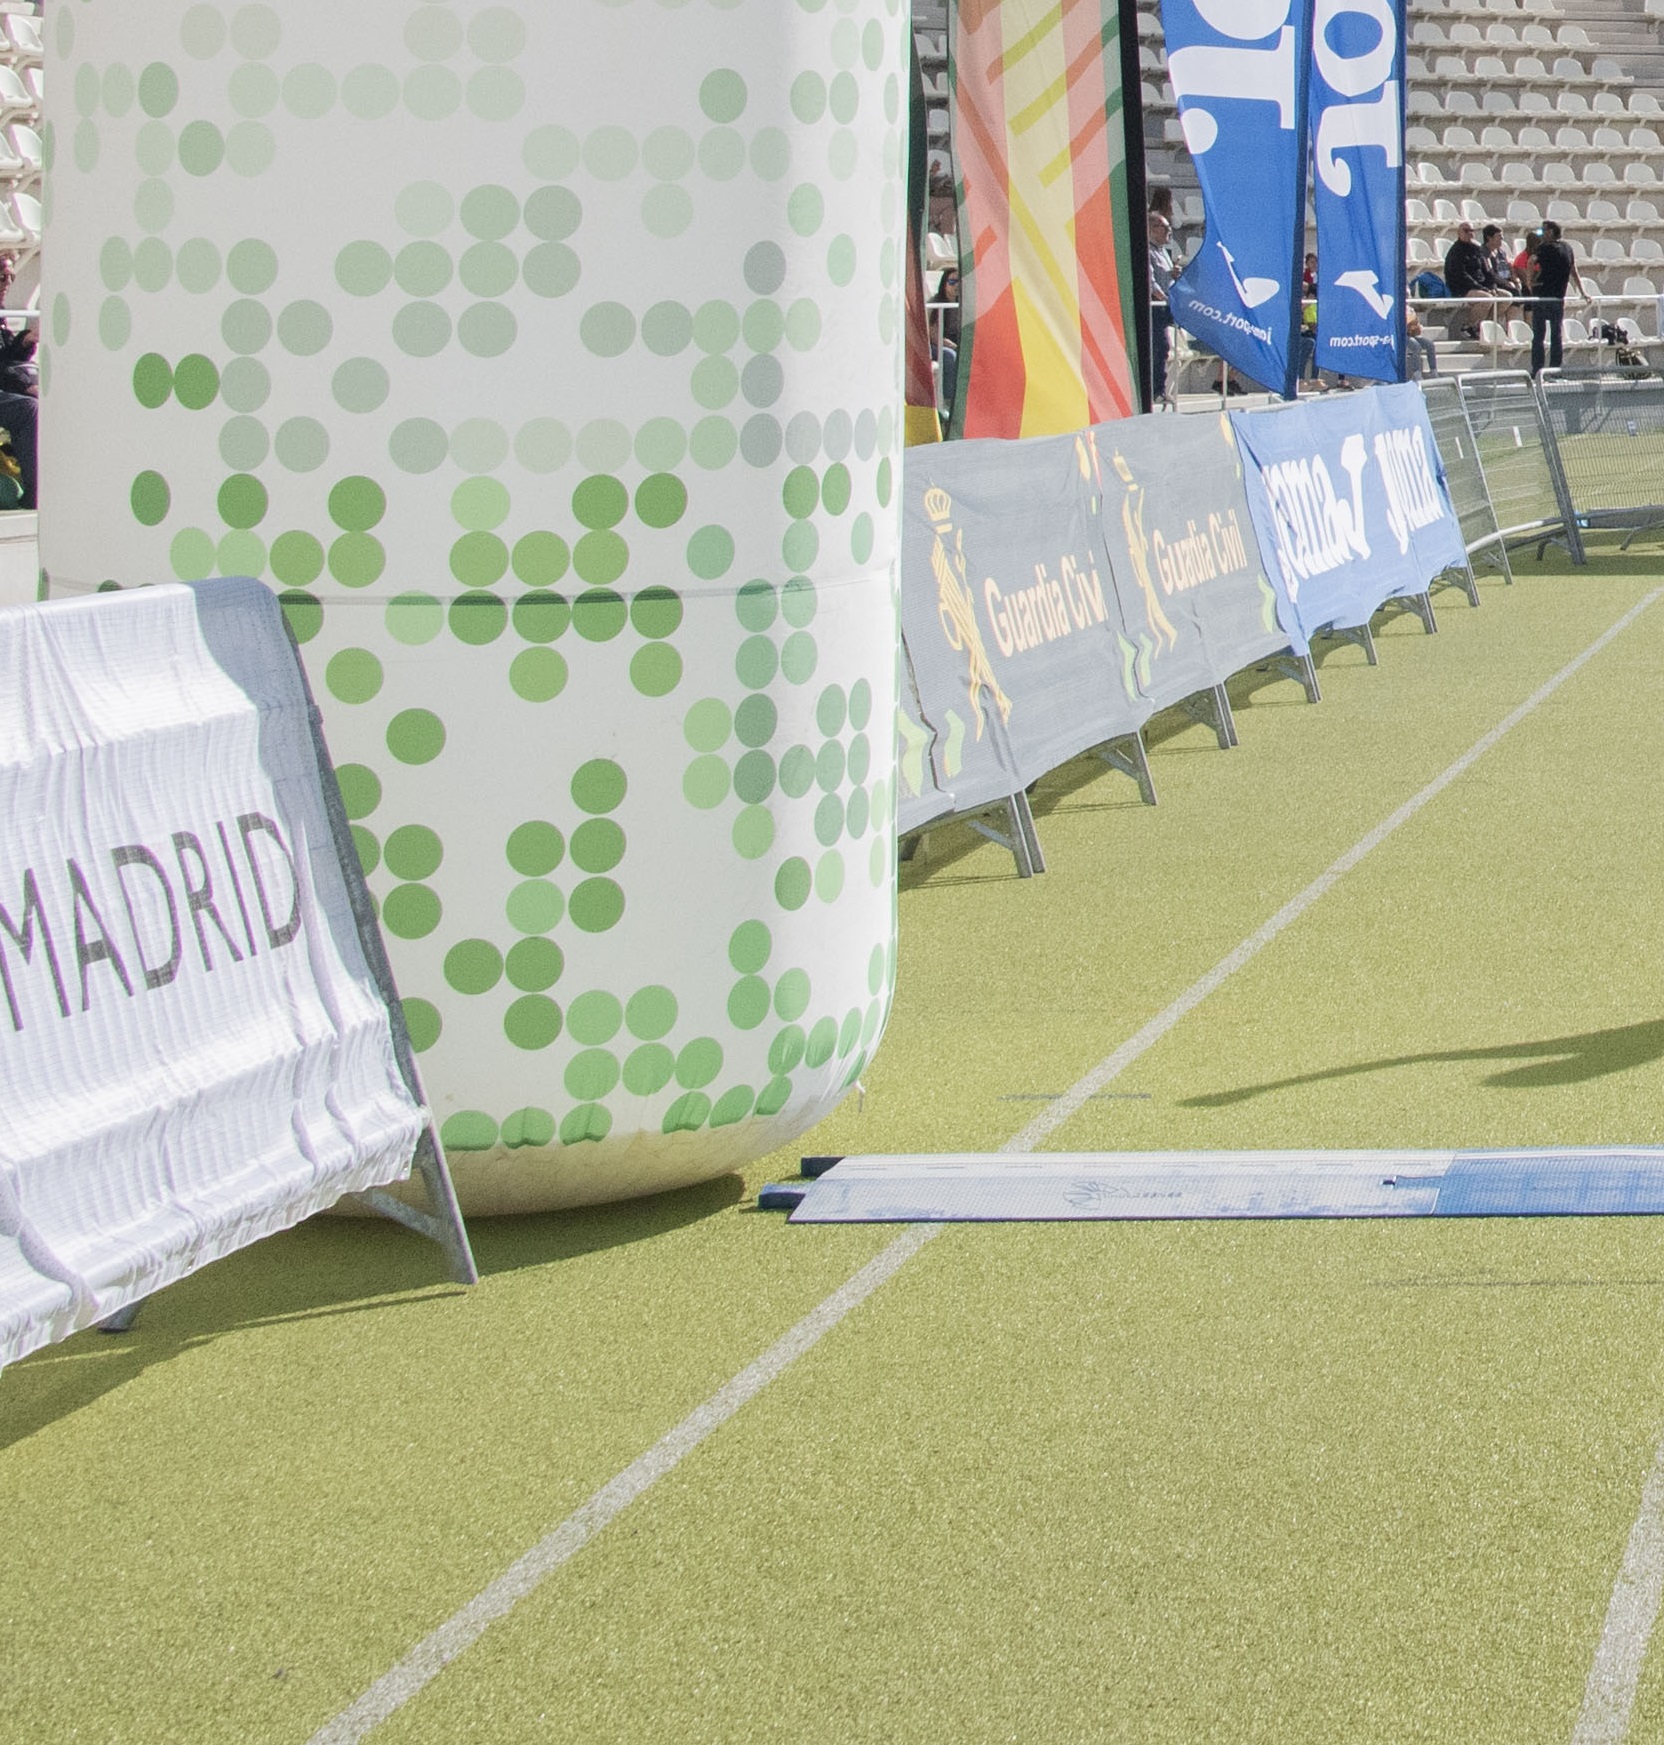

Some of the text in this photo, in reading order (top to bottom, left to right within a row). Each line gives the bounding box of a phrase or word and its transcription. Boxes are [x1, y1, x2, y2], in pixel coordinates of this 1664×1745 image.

[1153, 509, 1248, 596] Guardia Civil
[984, 564, 1071, 657] Guardia
[0, 811, 303, 1033] MADRID
